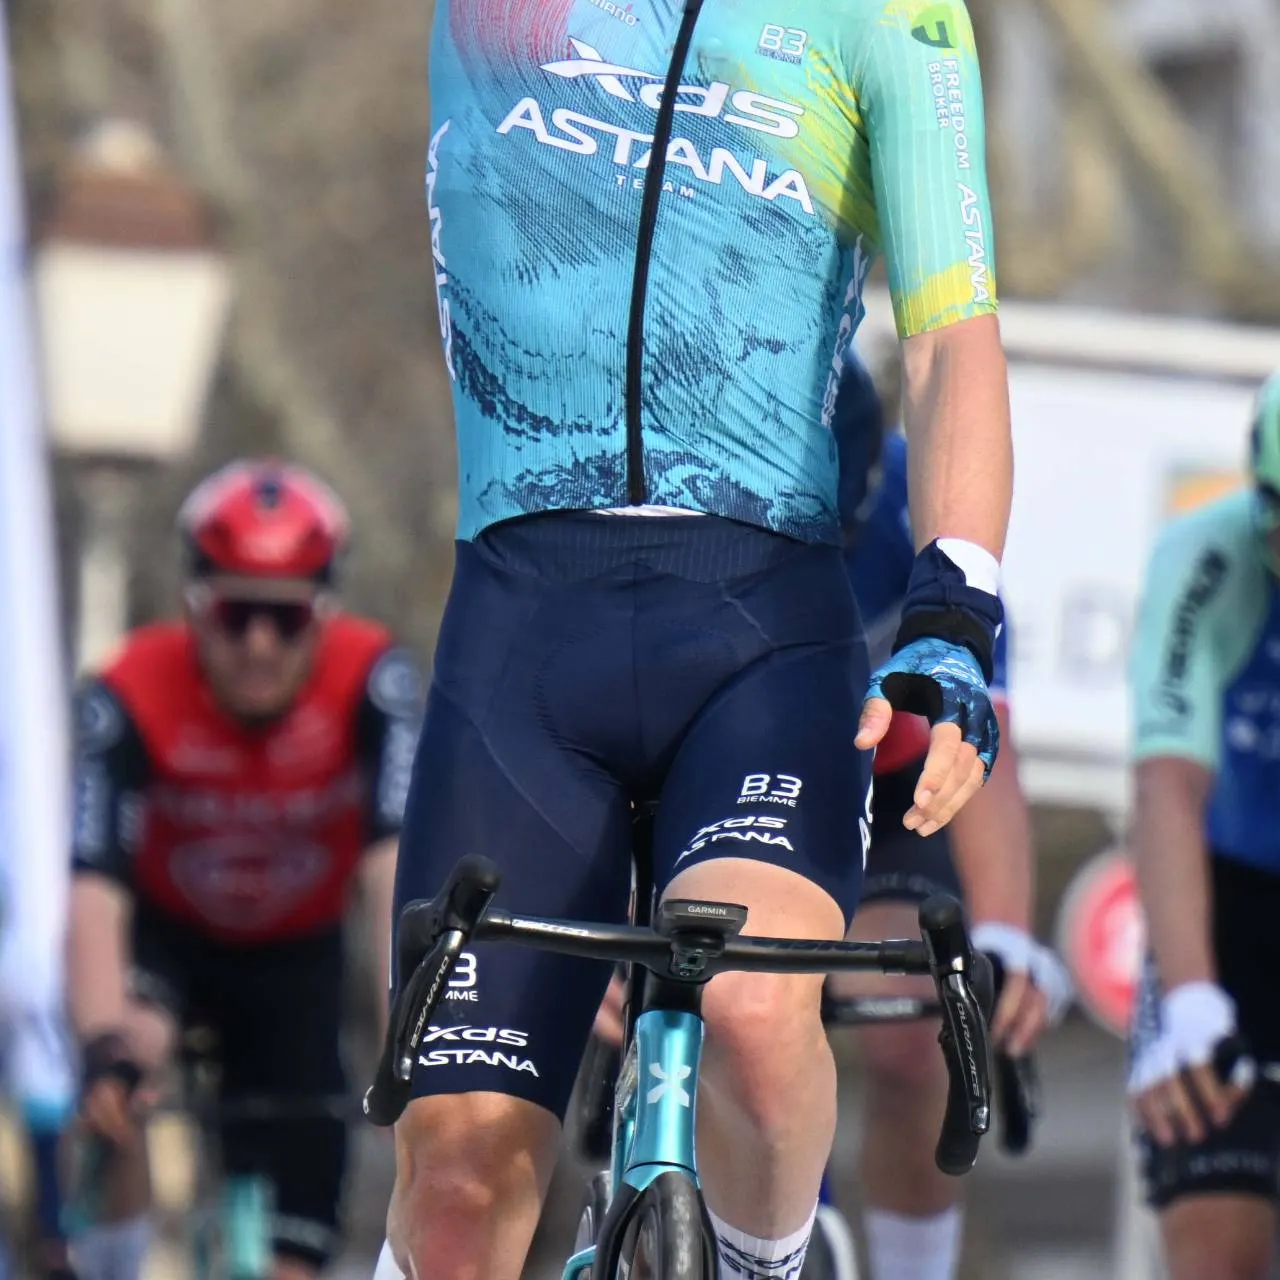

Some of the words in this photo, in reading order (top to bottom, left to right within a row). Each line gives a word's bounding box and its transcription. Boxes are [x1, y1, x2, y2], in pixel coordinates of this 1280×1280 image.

[759, 23, 807, 56] B3
[928, 61, 950, 129] BROKER
[943, 59, 970, 170] FREEDOM
[496, 97, 816, 215] ASTANA
[616, 174, 695, 199] TEAM
[957, 182, 989, 304] ASTANA
[736, 795, 797, 808] BIEMME
[741, 774, 803, 798] B3
[687, 905, 727, 917] GARMIN
